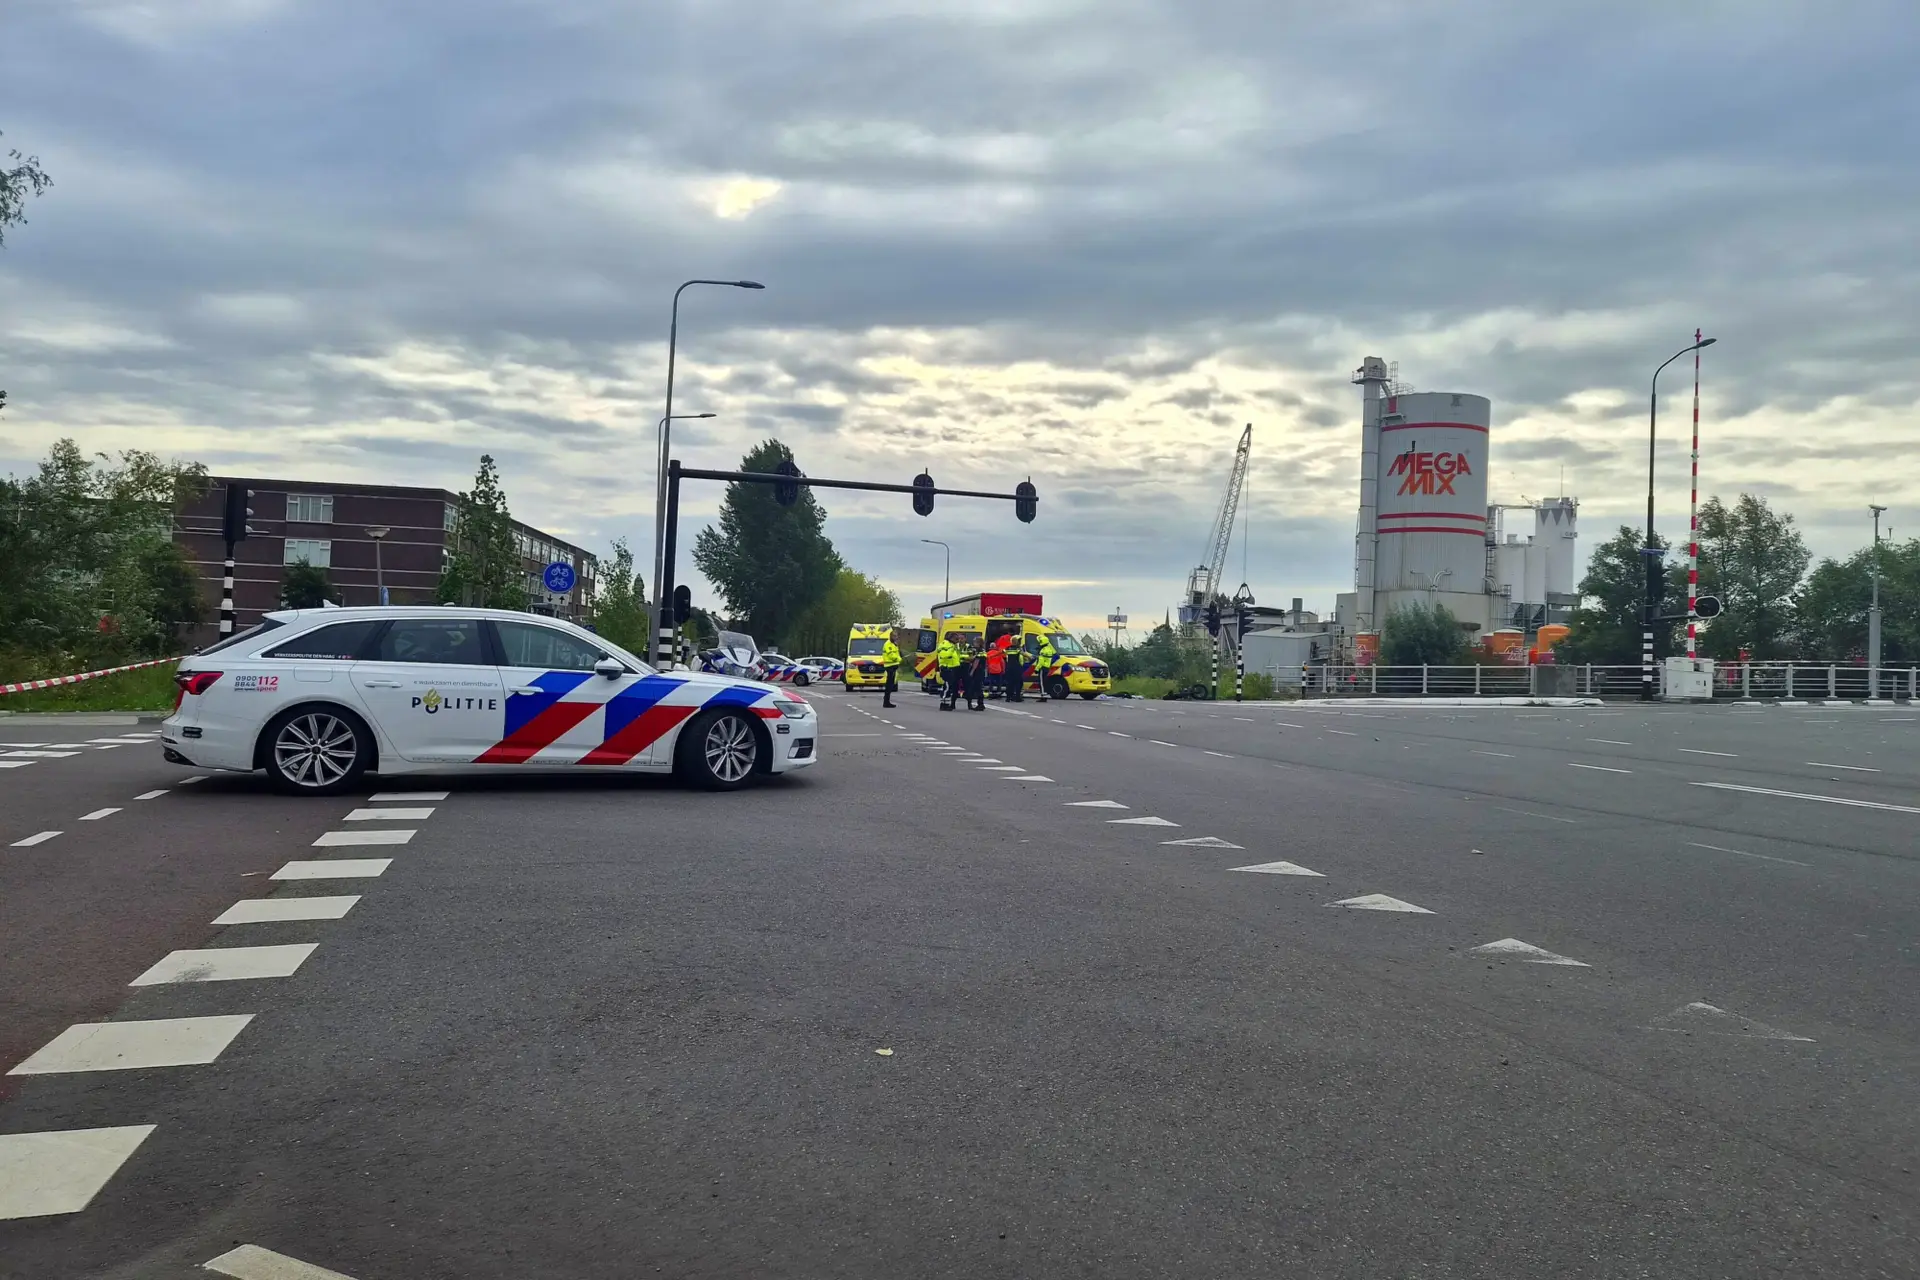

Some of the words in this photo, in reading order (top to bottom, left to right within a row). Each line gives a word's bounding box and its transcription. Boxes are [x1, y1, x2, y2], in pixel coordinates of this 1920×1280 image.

[1387, 452, 1472, 476] MEGA
[1397, 473, 1456, 496] MIX
[258, 676, 278, 686] 112
[412, 696, 496, 714] POLITIE
